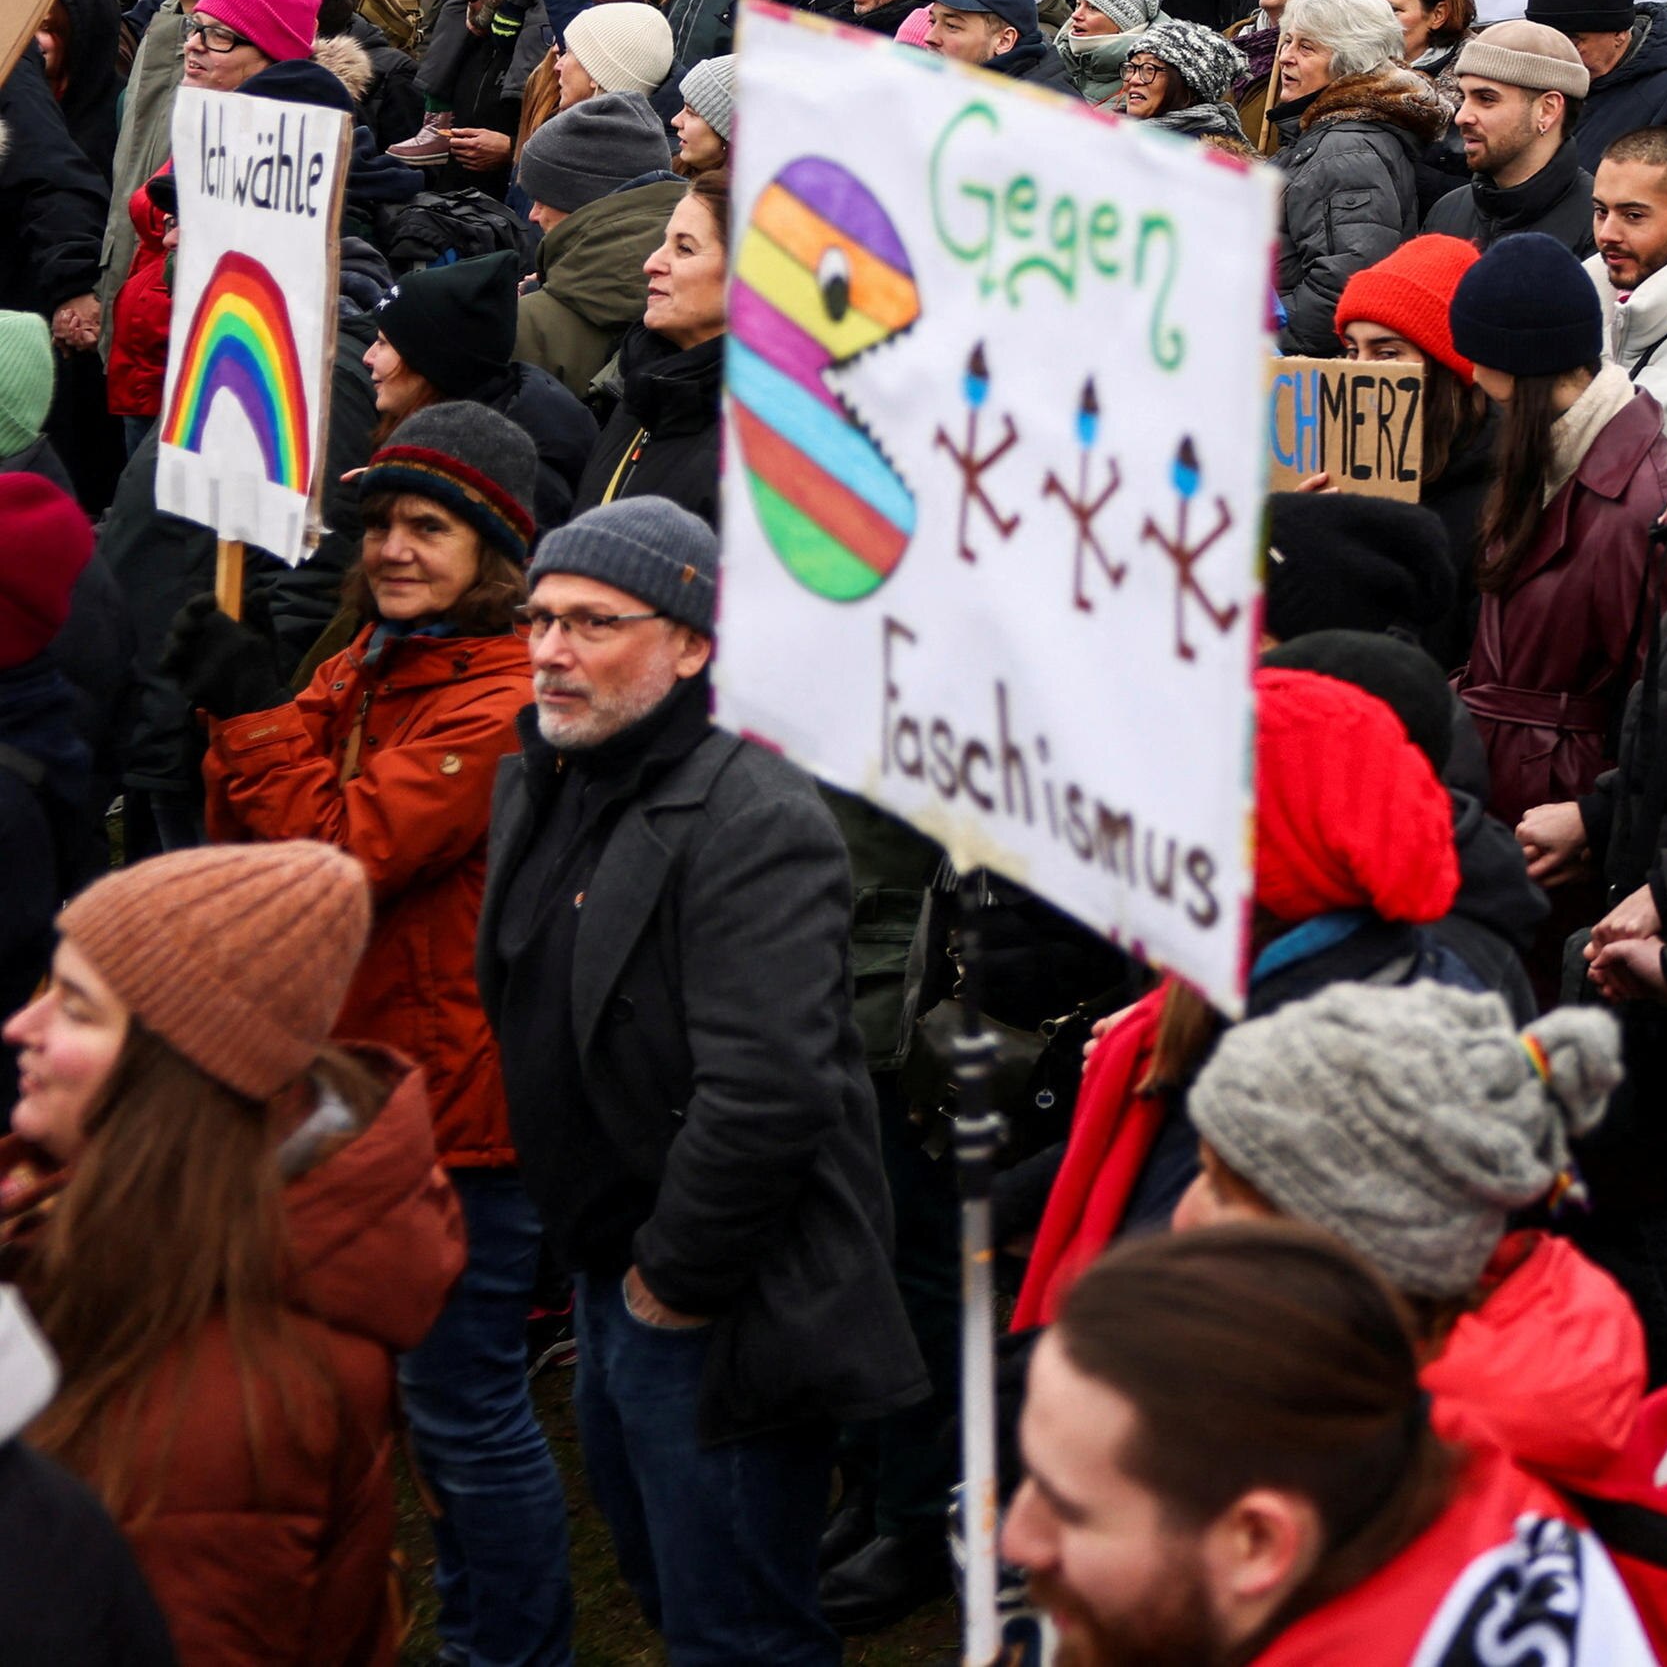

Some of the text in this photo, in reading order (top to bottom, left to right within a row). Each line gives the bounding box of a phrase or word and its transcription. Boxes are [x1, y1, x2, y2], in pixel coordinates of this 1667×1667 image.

[199, 100, 325, 219] Ich wähle
[928, 97, 1187, 372] Gegen
[879, 615, 1221, 929] Faschismus
